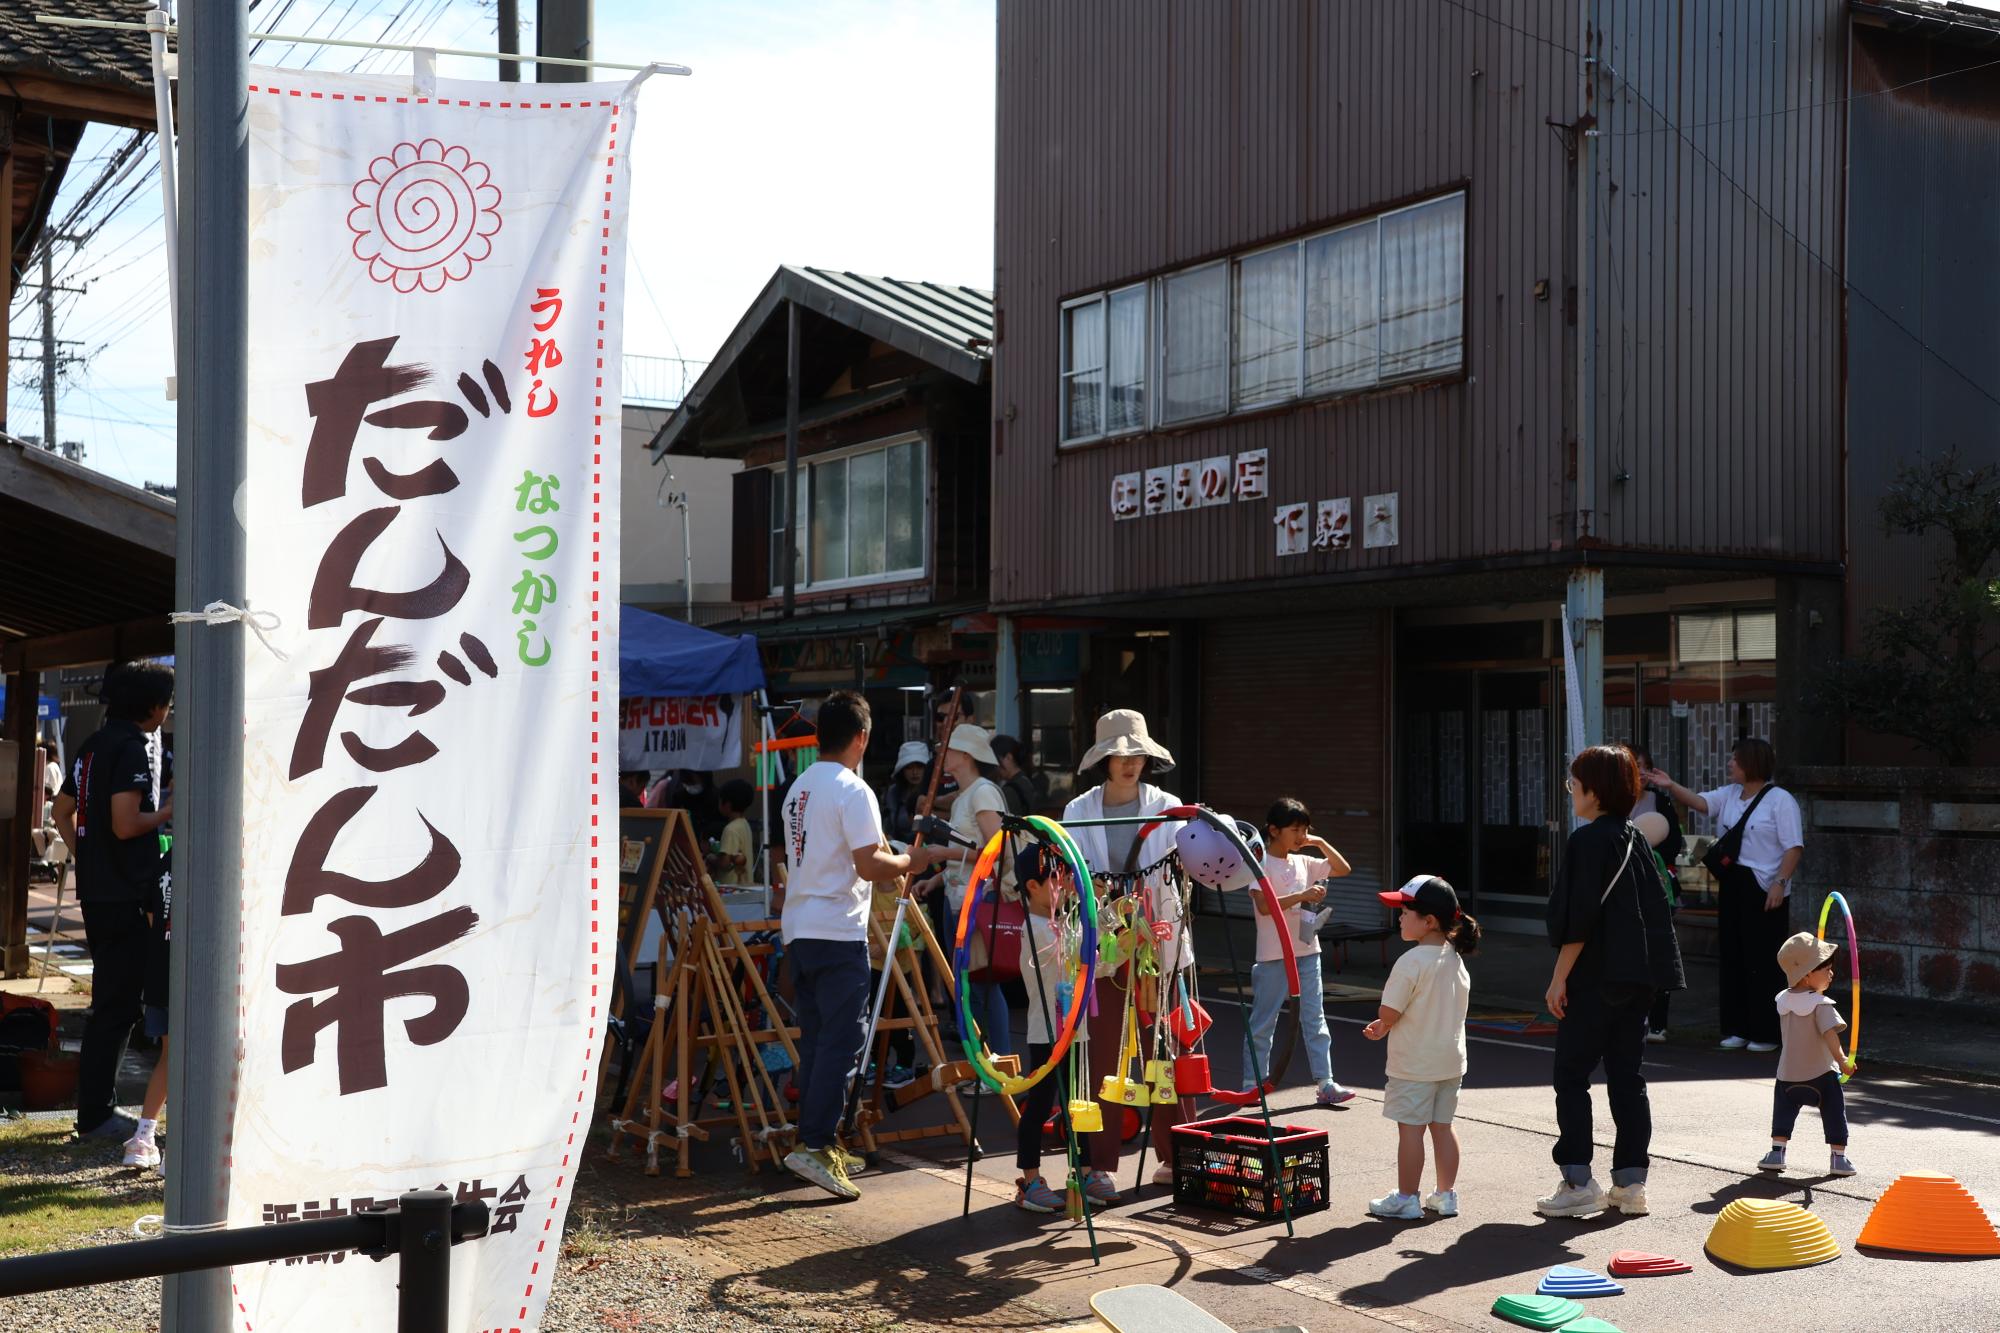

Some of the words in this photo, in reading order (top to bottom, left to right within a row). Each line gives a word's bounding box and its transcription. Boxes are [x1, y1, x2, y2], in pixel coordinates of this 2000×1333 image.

[524, 288, 563, 418] うれし
[511, 469, 561, 667] なつかし
[276, 335, 511, 1096] だんだん市
